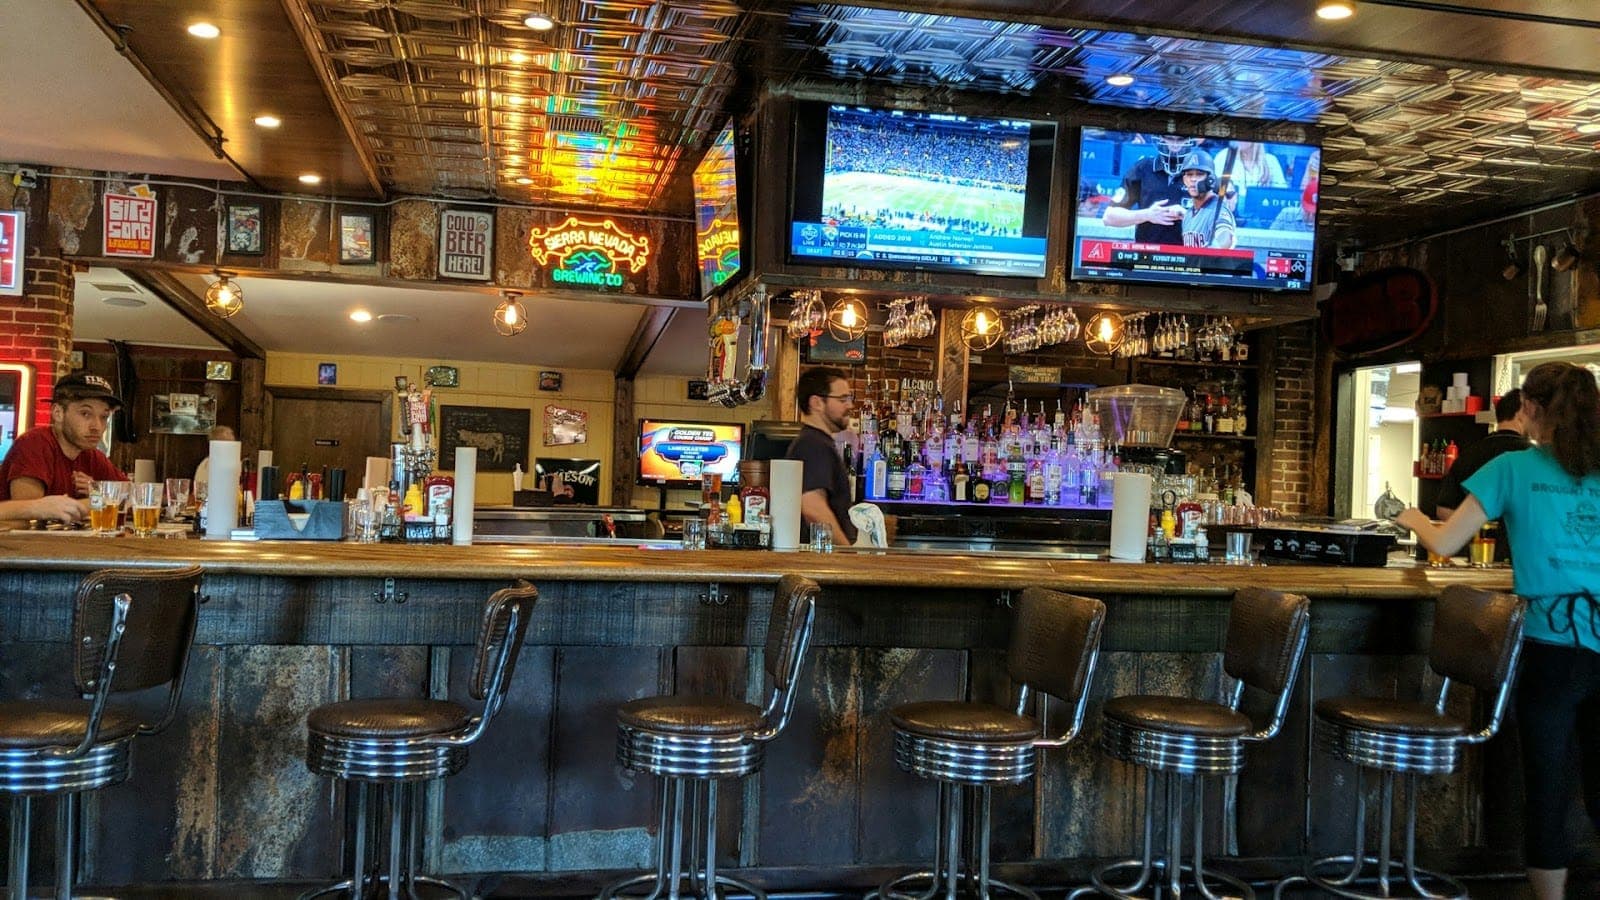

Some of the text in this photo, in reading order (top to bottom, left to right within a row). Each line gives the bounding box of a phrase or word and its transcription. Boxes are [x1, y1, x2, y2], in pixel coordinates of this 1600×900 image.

[1272, 199, 1300, 207] DELT
[446, 214, 475, 231] COLD
[446, 231, 486, 255] BEER
[544, 230, 636, 258] SIERRA NEVADA
[447, 255, 481, 273] HERE!
[552, 268, 605, 285] BREWING
